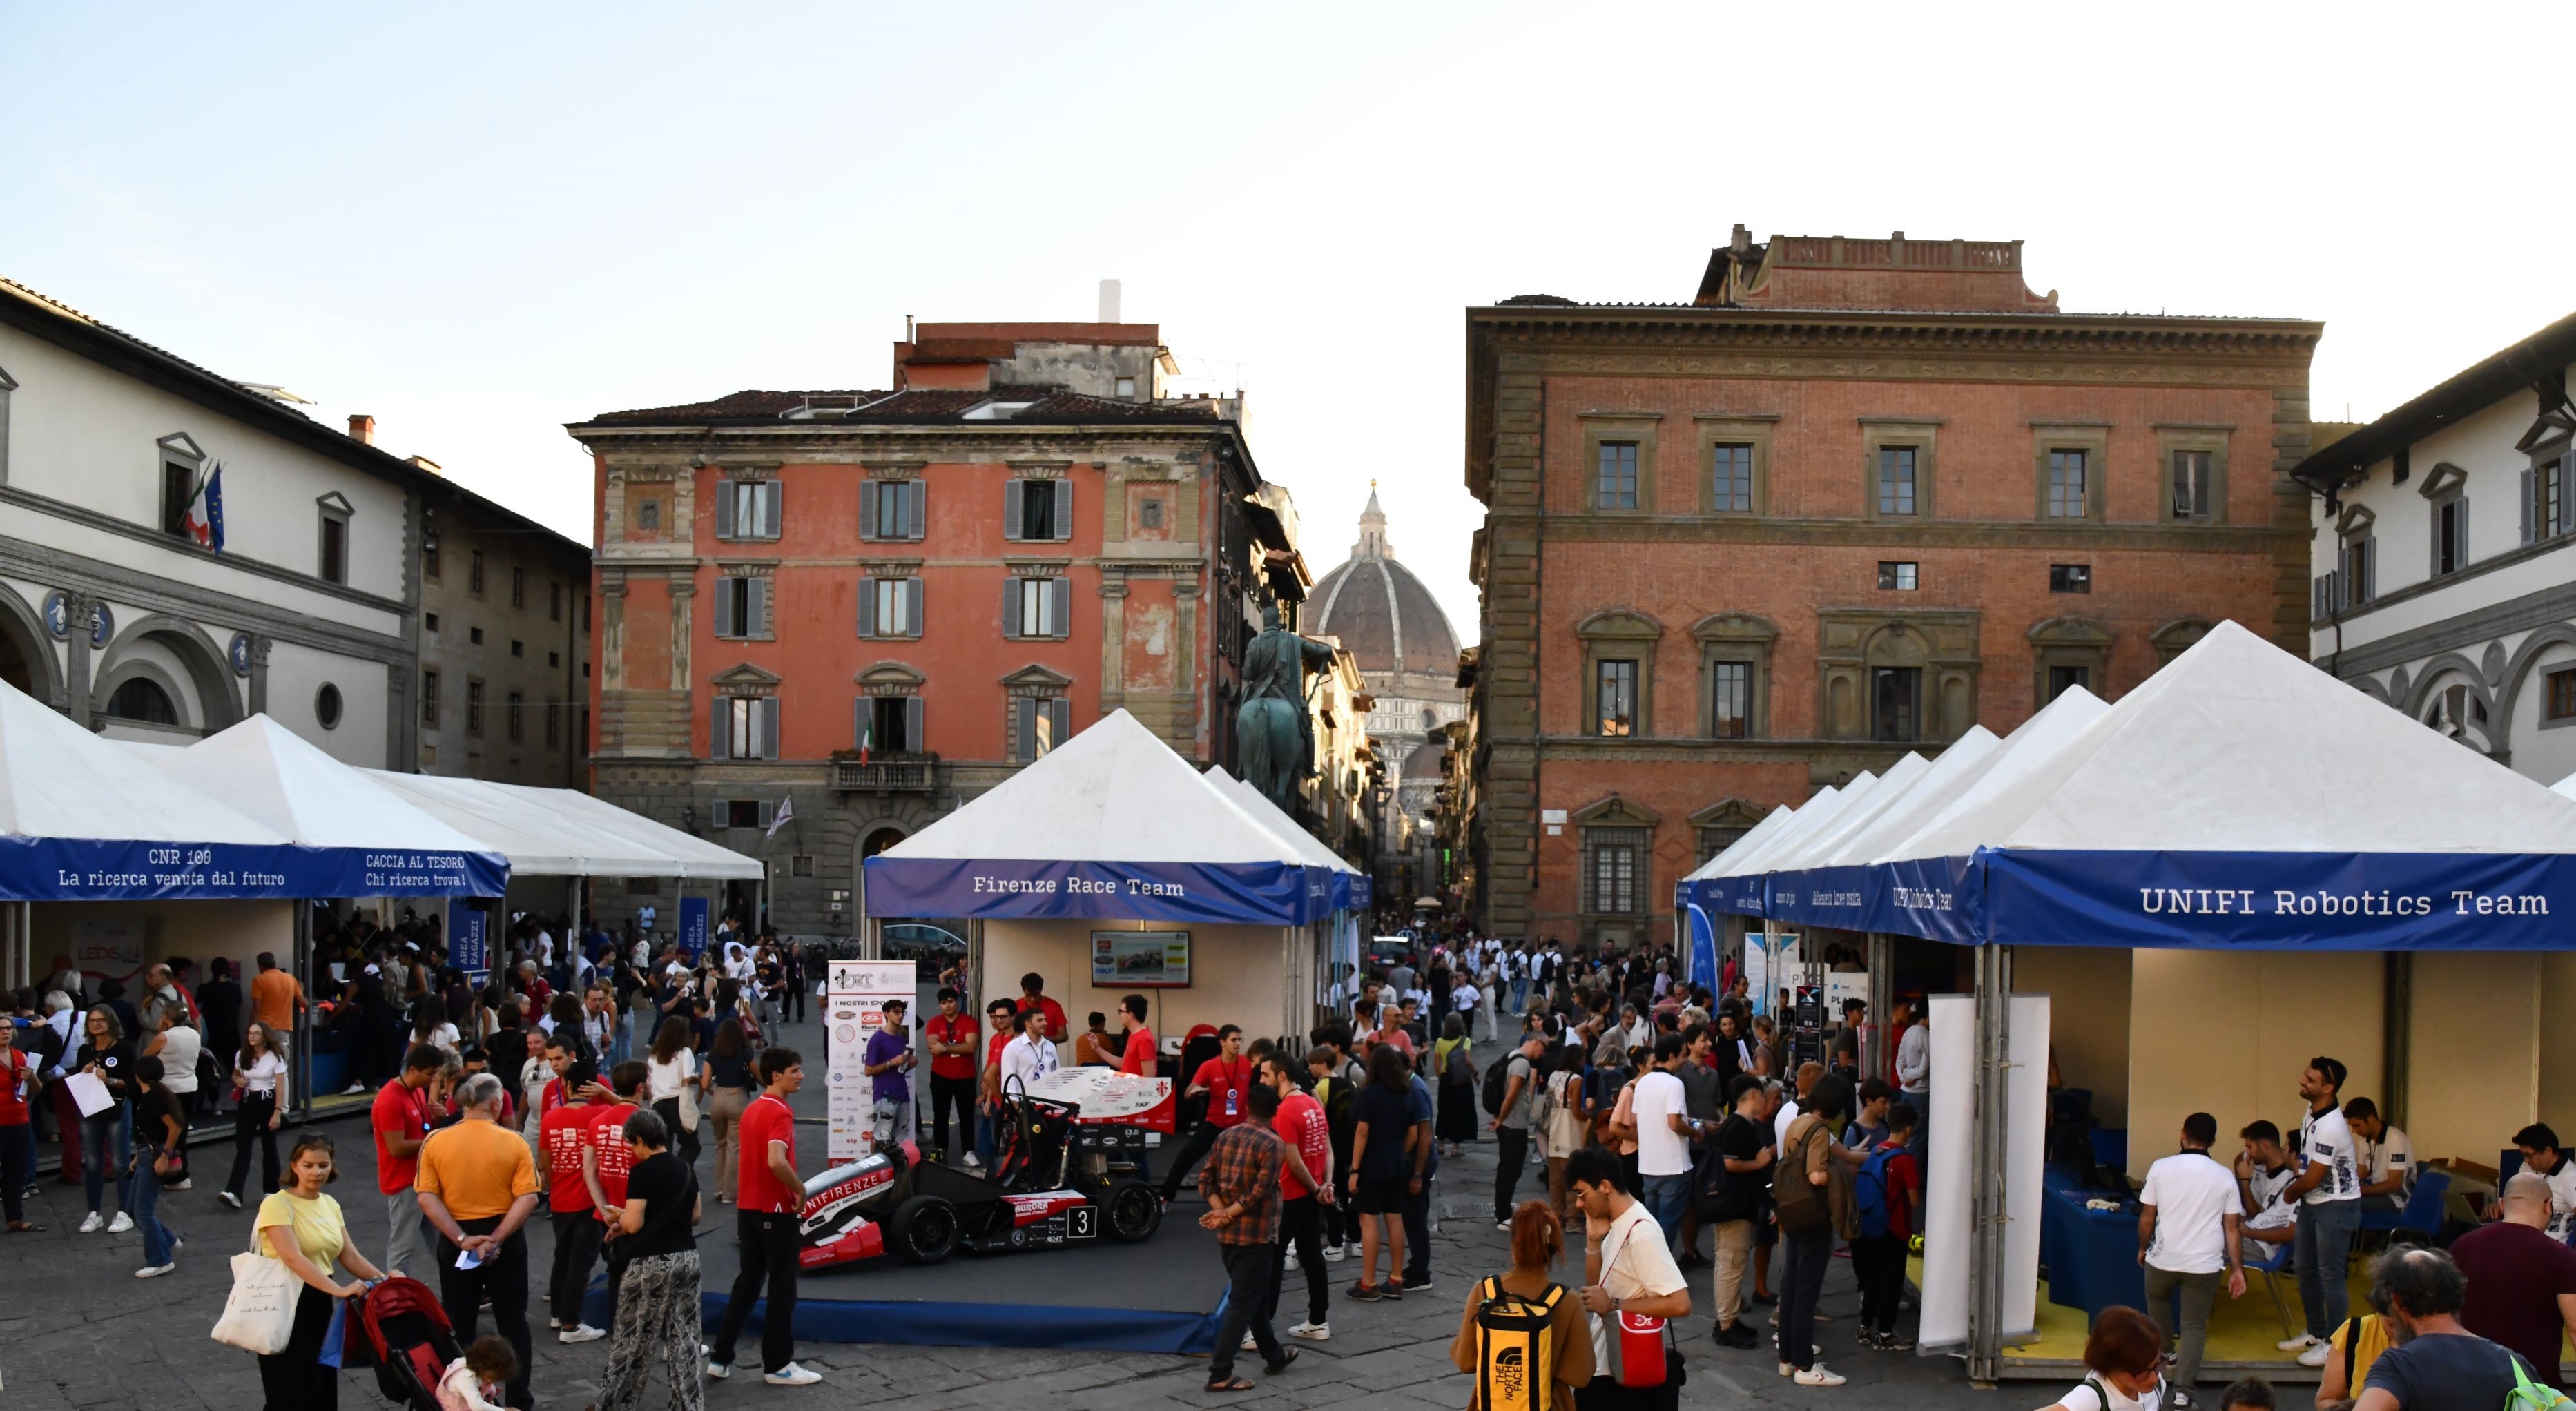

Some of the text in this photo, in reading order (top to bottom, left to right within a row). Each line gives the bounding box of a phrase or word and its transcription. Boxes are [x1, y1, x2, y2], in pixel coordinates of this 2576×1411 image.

[149, 849, 211, 864] CNR 100
[366, 855, 465, 869] CACCIA AL TESORO
[59, 870, 284, 886] La ricerca venuta dal futuro
[366, 873, 466, 886] Chi ricerca trova!
[974, 876, 1185, 896] Firenze Race Team
[2141, 888, 2549, 915] UNIFI Robotics Team
[460, 937, 468, 965] AREA
[471, 919, 479, 965] RAGAZZI
[1015, 1202, 1049, 1214] AURORA
[1078, 1210, 1088, 1234] 3
[1495, 1365, 1504, 1384] THE
[1504, 1365, 1514, 1401] NORTH
[1513, 1365, 1522, 1392] FACE
